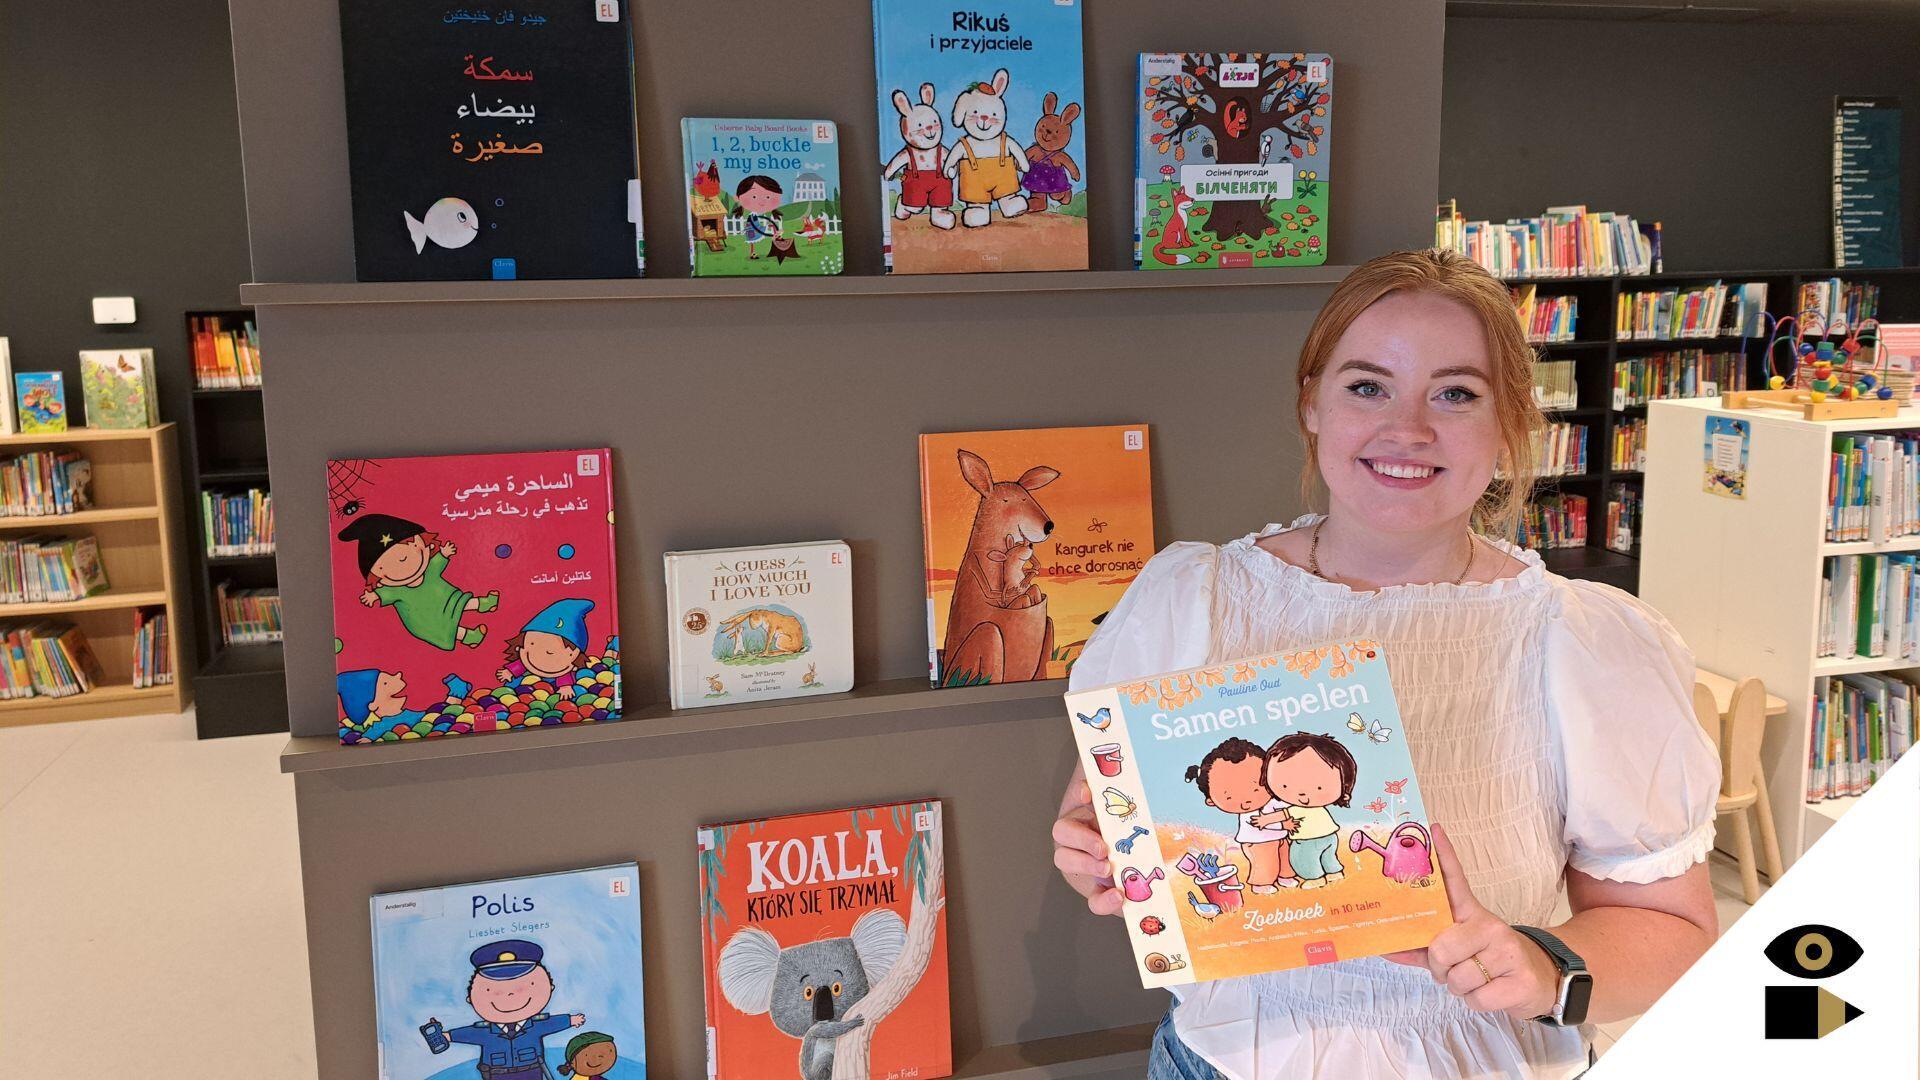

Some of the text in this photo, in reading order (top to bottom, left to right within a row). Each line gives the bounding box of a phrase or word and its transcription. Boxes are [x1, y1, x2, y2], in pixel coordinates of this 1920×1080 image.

[600, 3, 613, 18] EL
[952, 11, 1010, 32] Rikuś
[930, 34, 1033, 53] i przyjaciele
[463, 53, 534, 81] سمكة
[1311, 66, 1322, 78] EL
[456, 92, 536, 125] بيضاء
[817, 126, 829, 138] EL
[450, 132, 543, 162] صغيرة
[712, 135, 811, 153] 1, 2, buckle
[724, 154, 802, 174] my shoe
[1205, 169, 1269, 178] Осінні пригоди
[1196, 181, 1278, 195] БІЛЧЕНЯТИ
[1616, 394, 1622, 403] N
[1128, 434, 1138, 446] EL
[582, 458, 594, 470] EL
[454, 474, 573, 502] الساحرة ميمي
[442, 497, 588, 521] تذهب في رحلة مدرسية
[1055, 539, 1135, 557] Kangurek nie
[734, 559, 786, 572] GUESS
[831, 552, 842, 564] EL
[1048, 557, 1144, 576] chce dorosnąć
[714, 570, 807, 587] HOW MUCH
[710, 582, 812, 601] I LOVE YOU
[1218, 678, 1282, 698] Pauline Oud
[1150, 681, 1370, 741] Samen spelen
[920, 814, 929, 827] EL
[746, 830, 899, 893] KOALA,
[614, 882, 625, 894] EL
[384, 902, 417, 910] Anderstalig
[472, 893, 535, 918] Polis
[747, 879, 900, 922] KTÓRY SIĘ TRZYMAŁ
[1243, 900, 1381, 932] Zoekboek in 10 talen
[468, 921, 550, 939] Liesbet Slegers
[1308, 944, 1333, 954] Clavis
